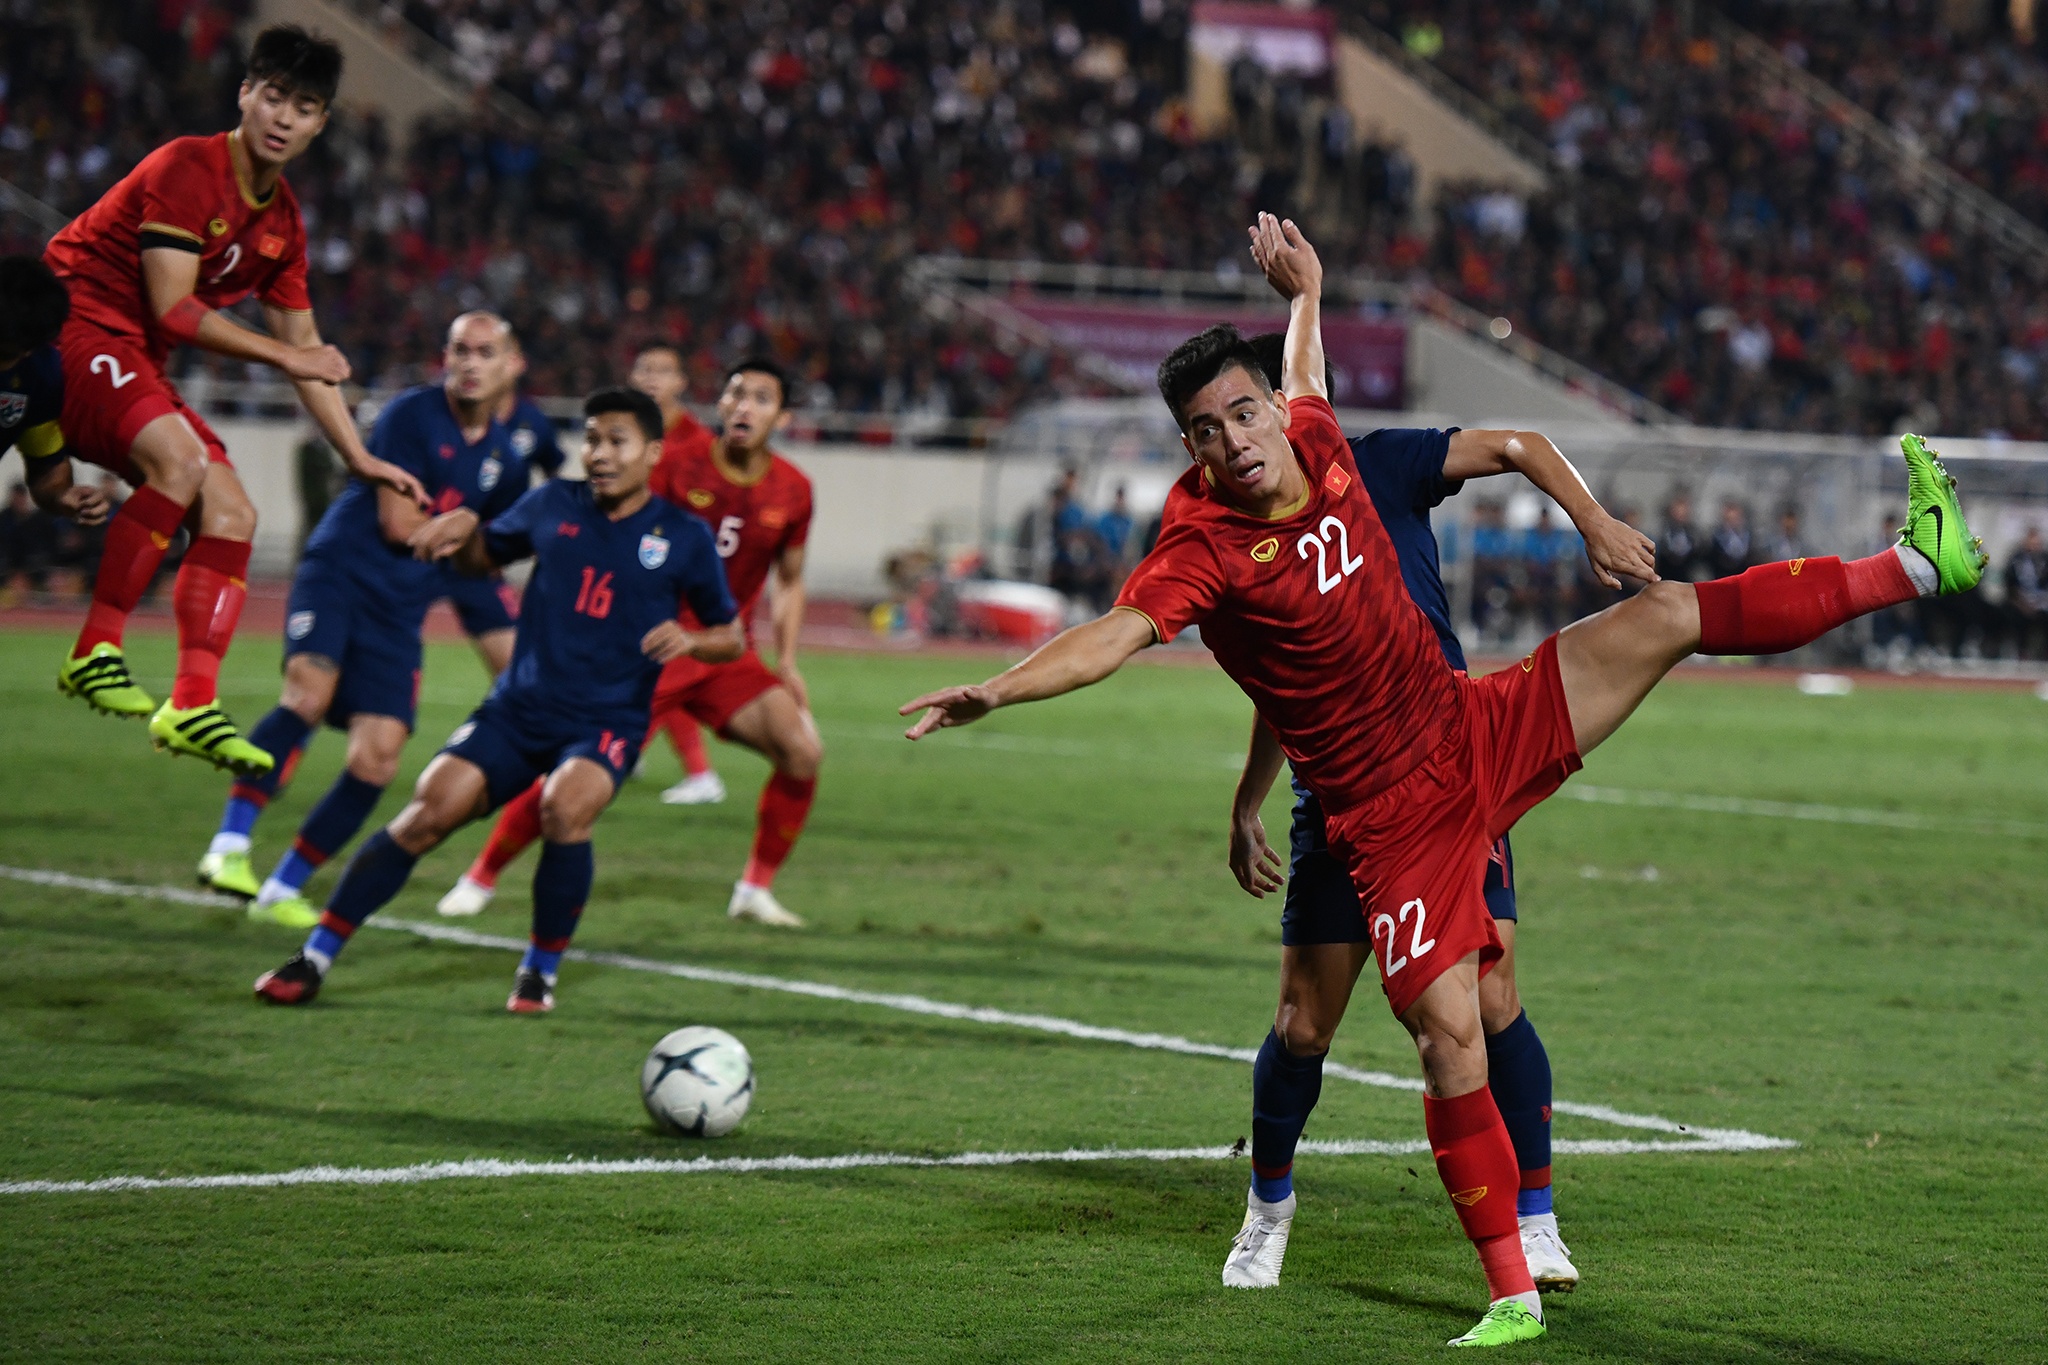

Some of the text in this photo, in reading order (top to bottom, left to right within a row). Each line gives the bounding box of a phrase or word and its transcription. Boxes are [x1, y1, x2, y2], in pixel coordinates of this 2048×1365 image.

[208, 243, 241, 284] 2
[89, 354, 137, 389] 2
[715, 515, 744, 558] 5
[1297, 515, 1364, 595] 22
[574, 565, 615, 619] 16
[1374, 897, 1436, 977] 22
